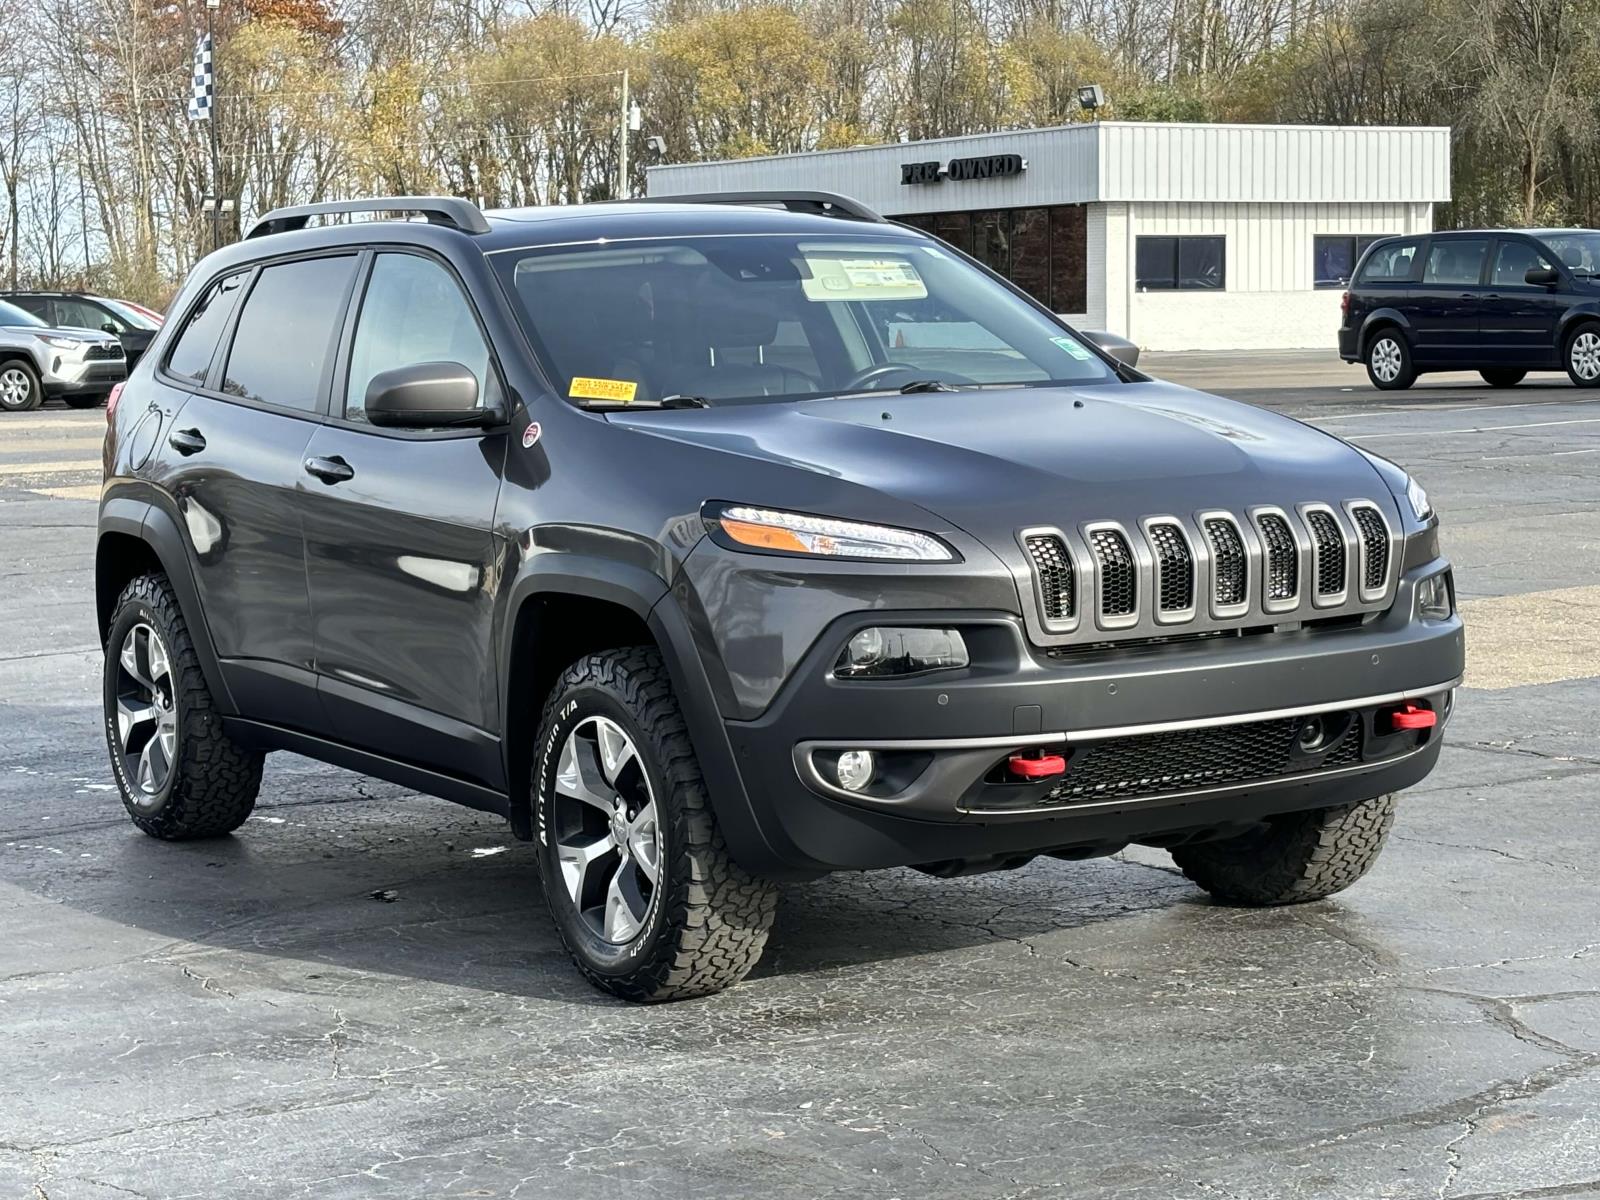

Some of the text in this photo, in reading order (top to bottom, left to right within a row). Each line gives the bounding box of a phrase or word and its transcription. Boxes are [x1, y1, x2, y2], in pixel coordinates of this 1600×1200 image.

[901, 154, 1022, 185] PRE-OWNED
[538, 699, 578, 847] All-Terrain T/A
